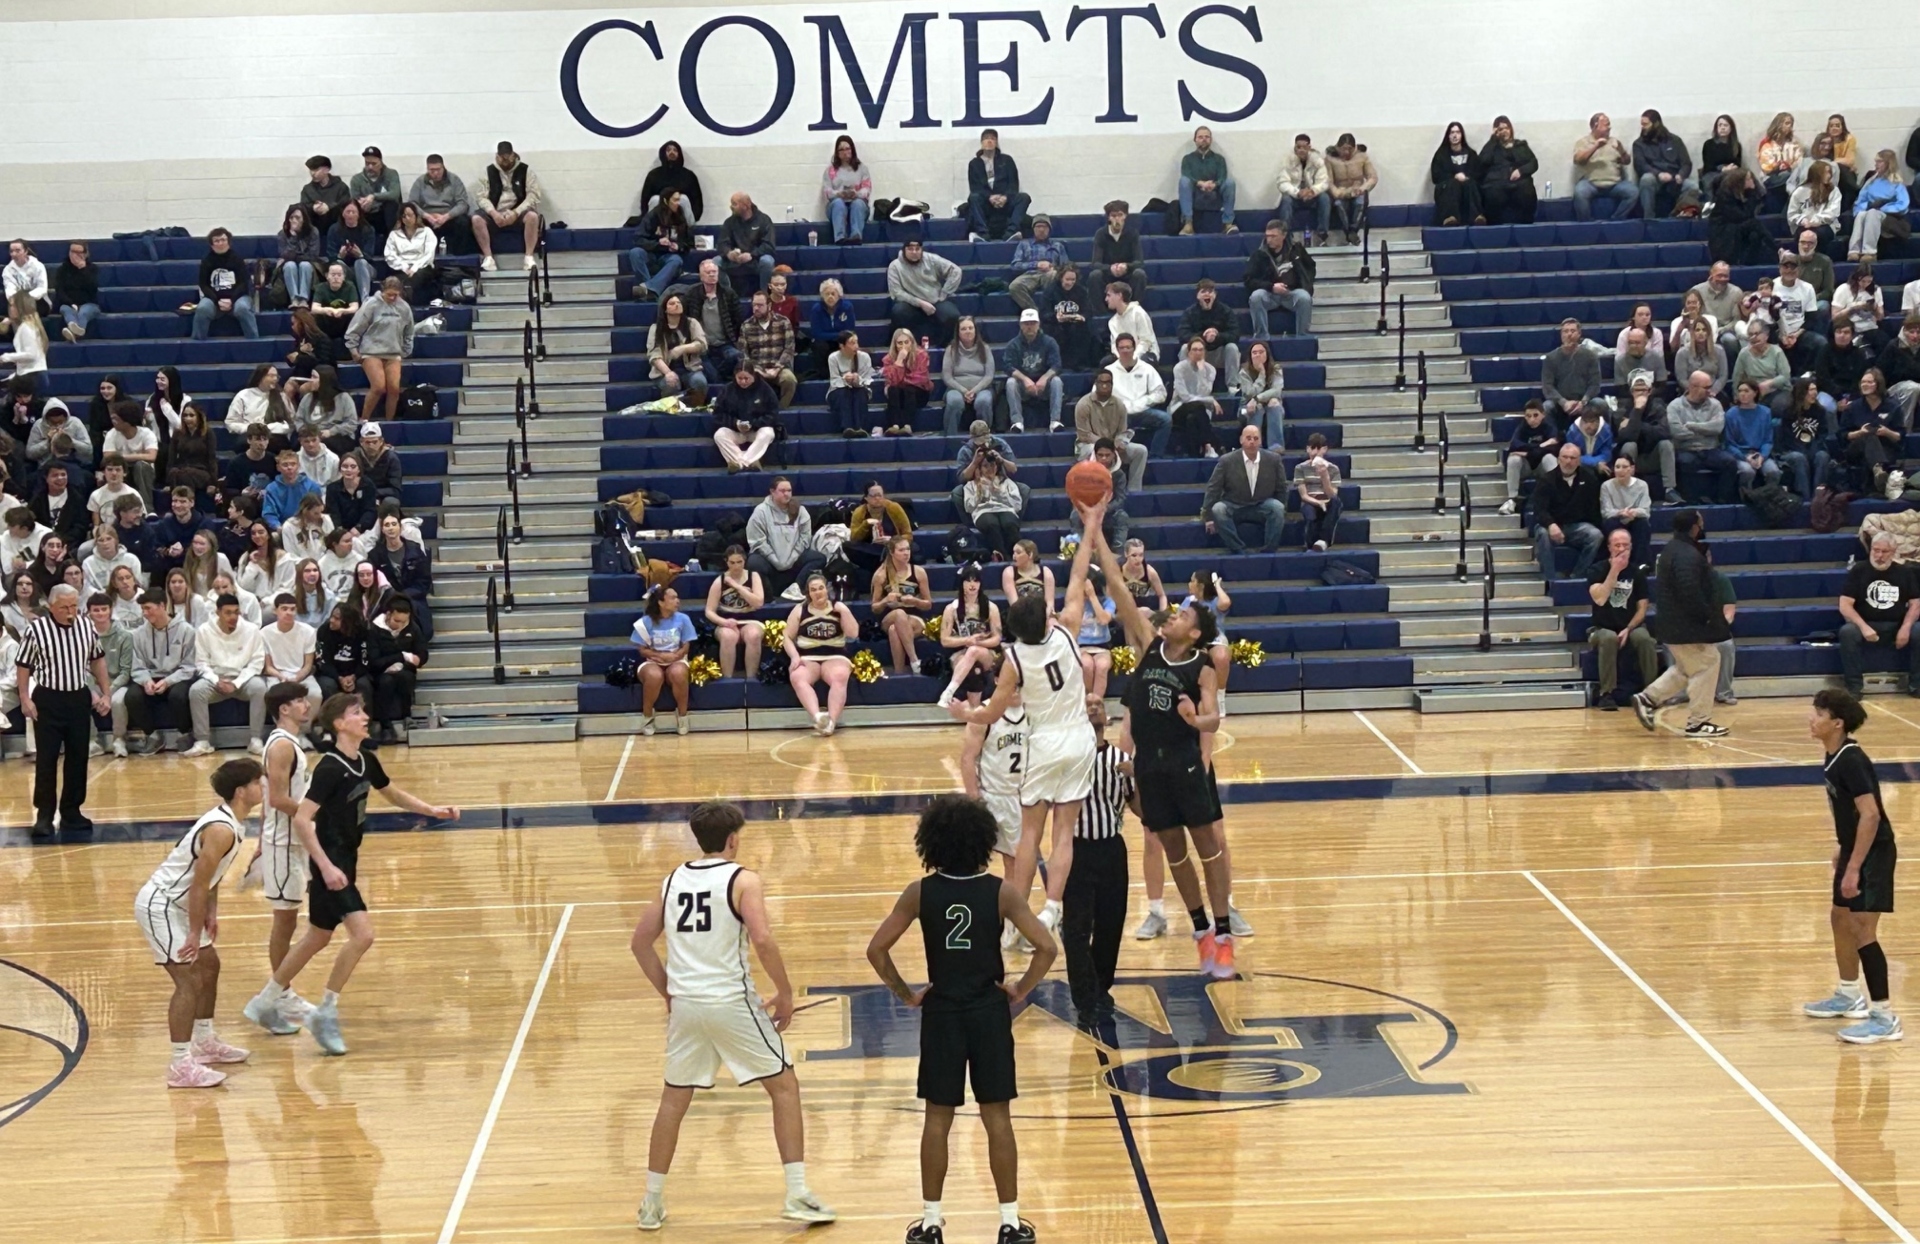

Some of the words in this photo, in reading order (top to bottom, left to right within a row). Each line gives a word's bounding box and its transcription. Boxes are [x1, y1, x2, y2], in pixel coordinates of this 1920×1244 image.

[560, 4, 1269, 138] COMETS
[1044, 660, 1065, 692] 0
[1149, 683, 1172, 711] 15
[1009, 752, 1021, 773] 2
[677, 891, 713, 933] 25
[945, 904, 972, 950] 2
